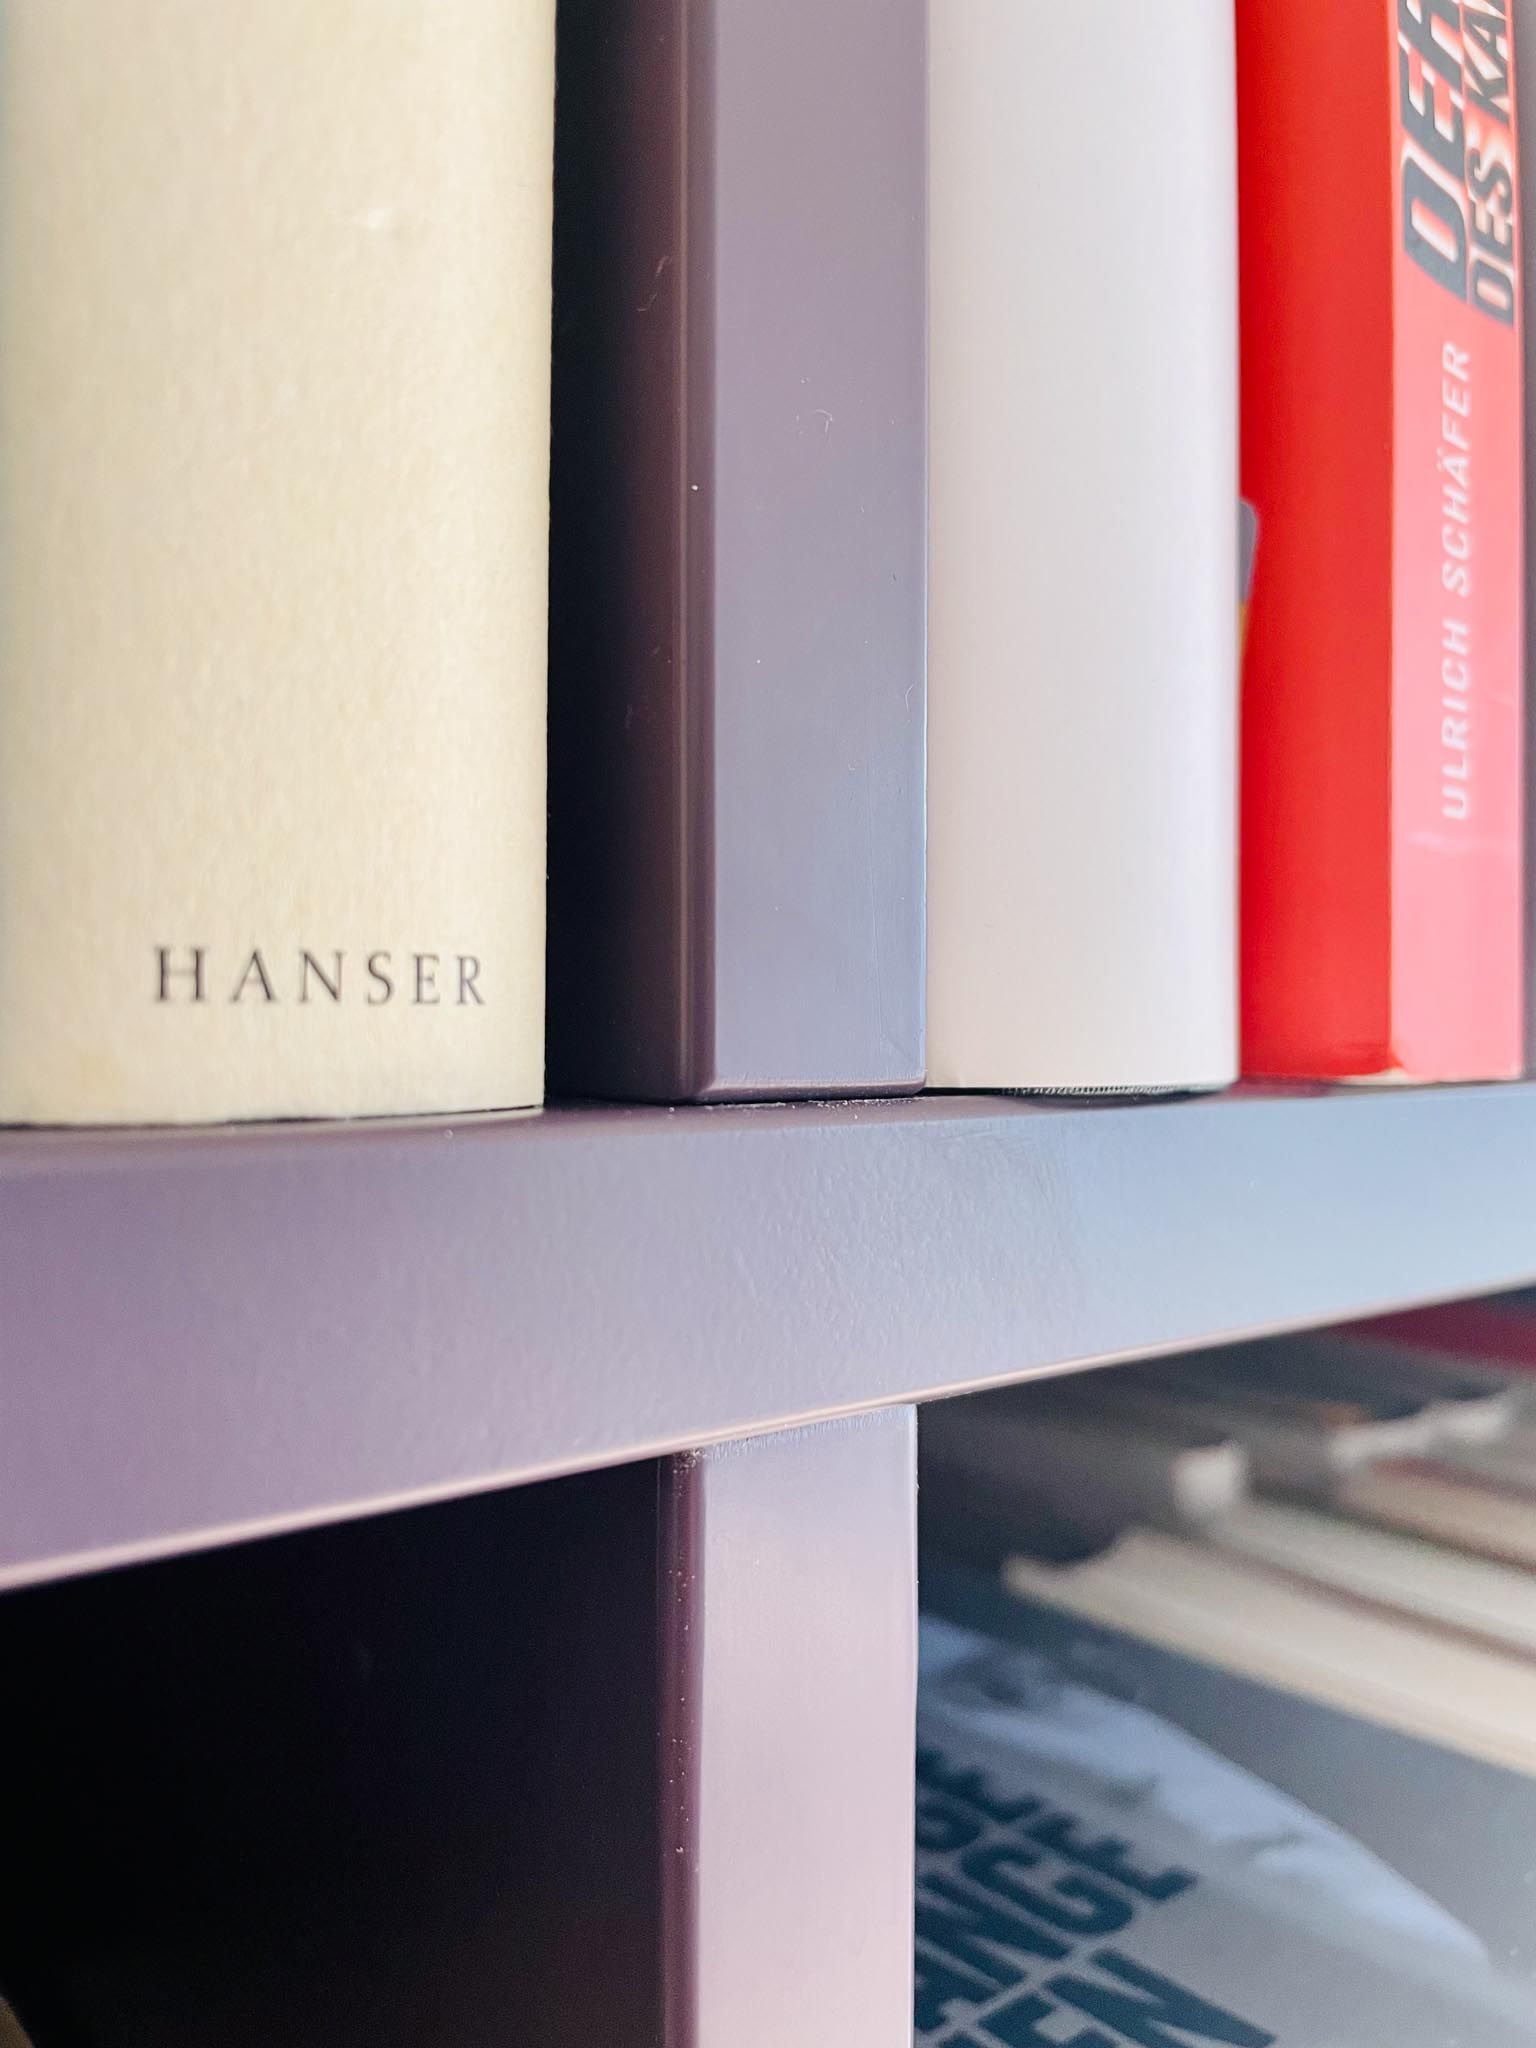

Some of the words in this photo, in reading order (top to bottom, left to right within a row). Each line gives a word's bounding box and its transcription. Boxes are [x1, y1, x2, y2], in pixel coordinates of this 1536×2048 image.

[1463, 148, 1514, 328] DES
[1436, 340, 1471, 597] SCHÄFER
[1441, 617, 1470, 821] ULRICH
[153, 945, 487, 1006] HANSER
